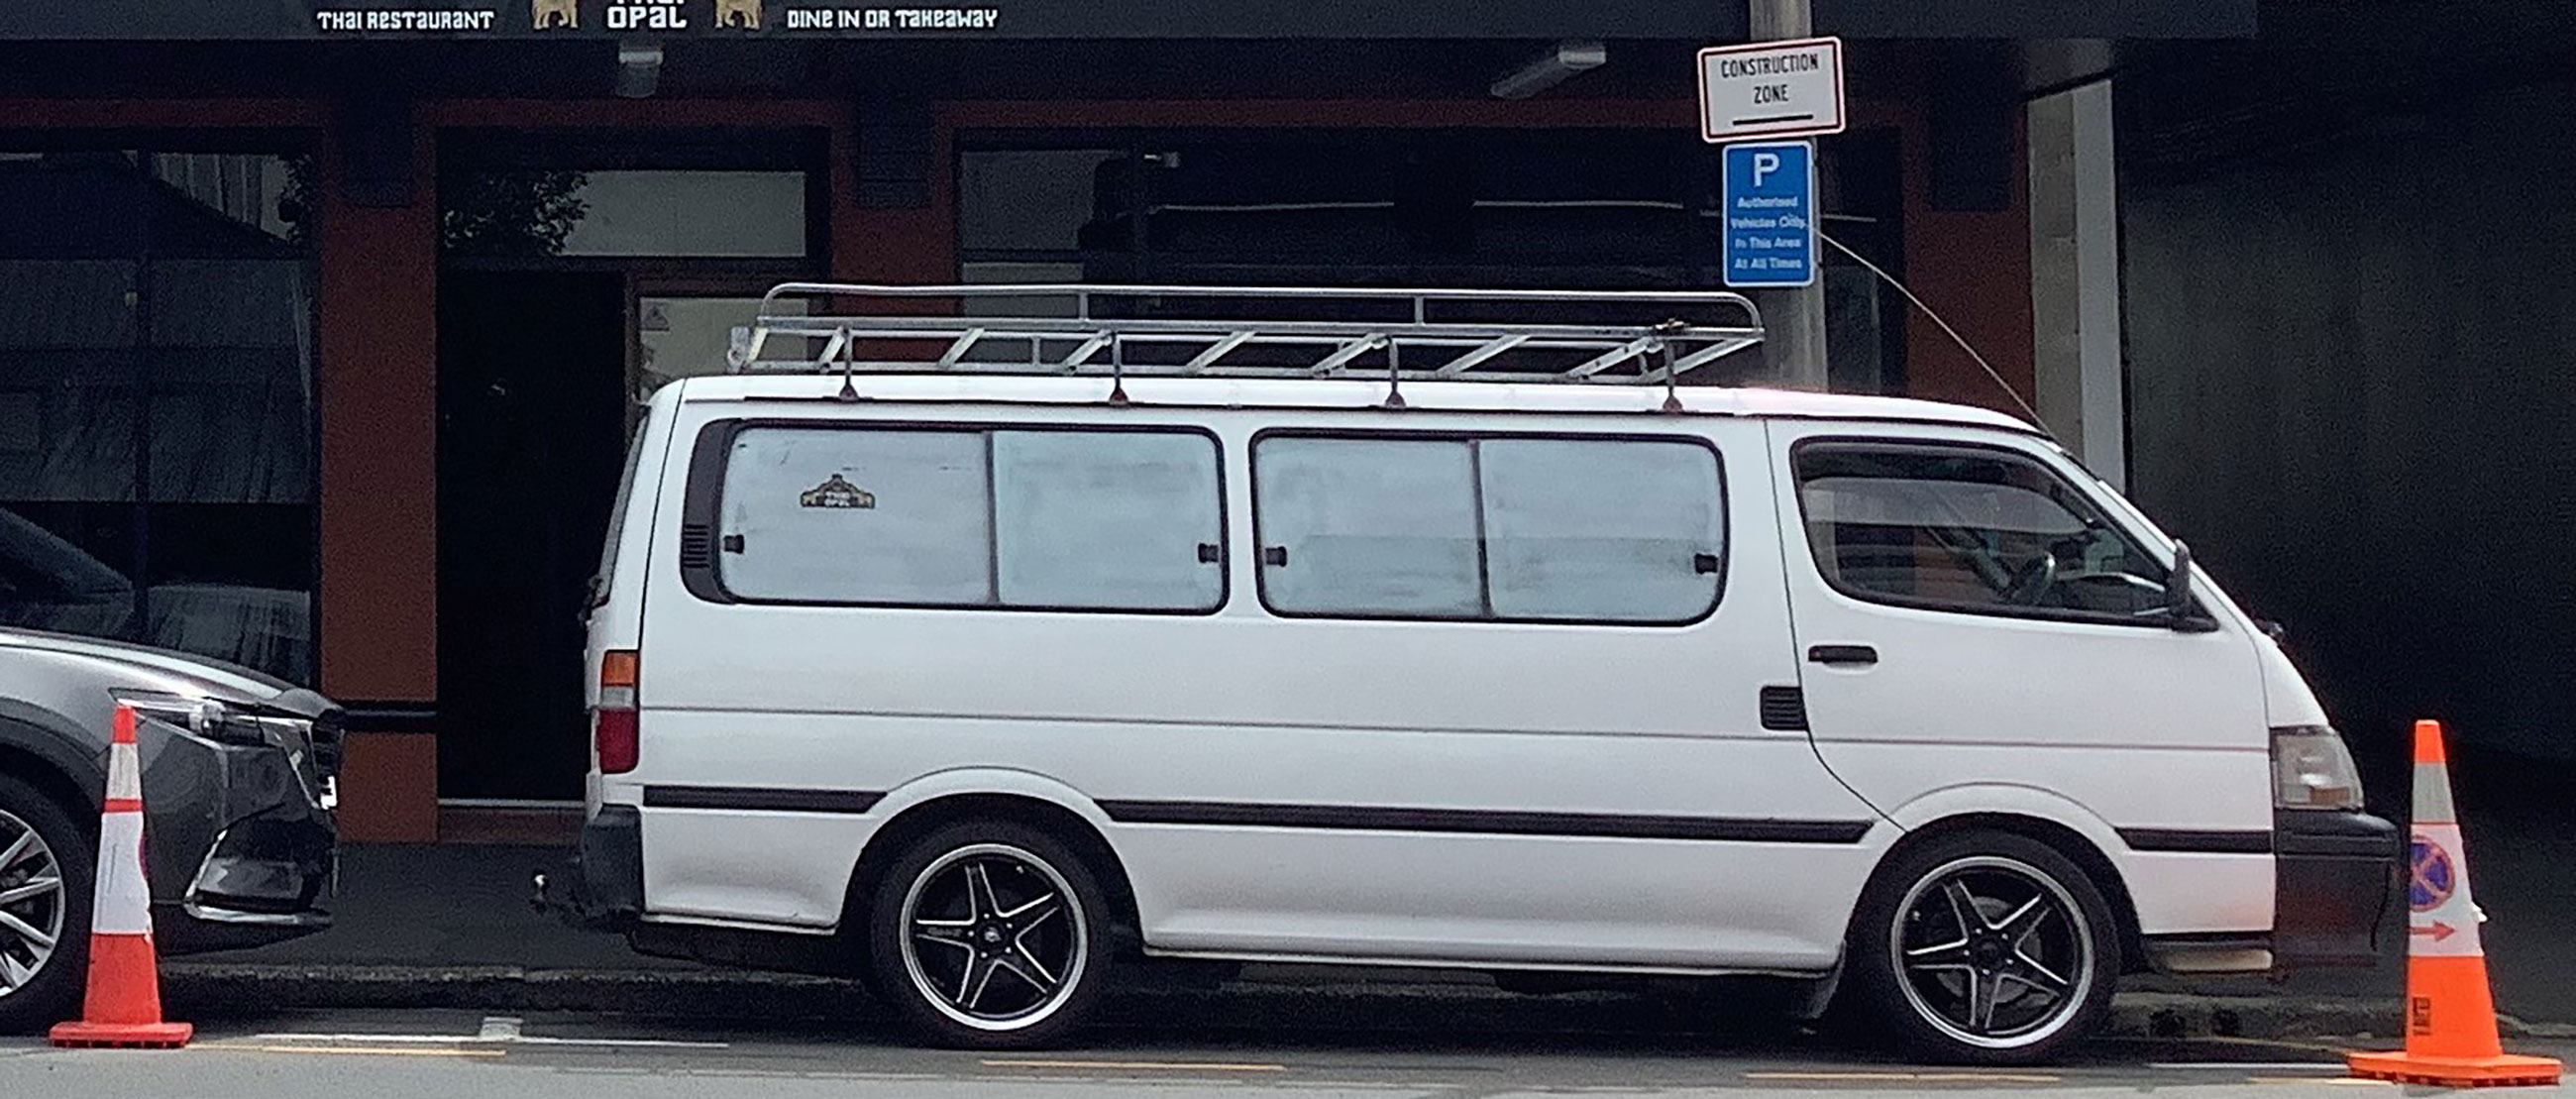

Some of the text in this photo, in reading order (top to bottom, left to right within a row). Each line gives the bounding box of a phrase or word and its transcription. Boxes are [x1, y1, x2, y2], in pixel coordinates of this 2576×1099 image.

[838, 9, 860, 28] IN
[865, 9, 890, 28] OR
[1721, 53, 1819, 78] CONSTRUCTION
[1753, 84, 1789, 104] ZONE
[1754, 153, 1780, 187] P
[1735, 238, 1747, 249] In
[1773, 237, 1801, 249] Area
[1734, 258, 1748, 269] At
[1751, 258, 1767, 269] All
